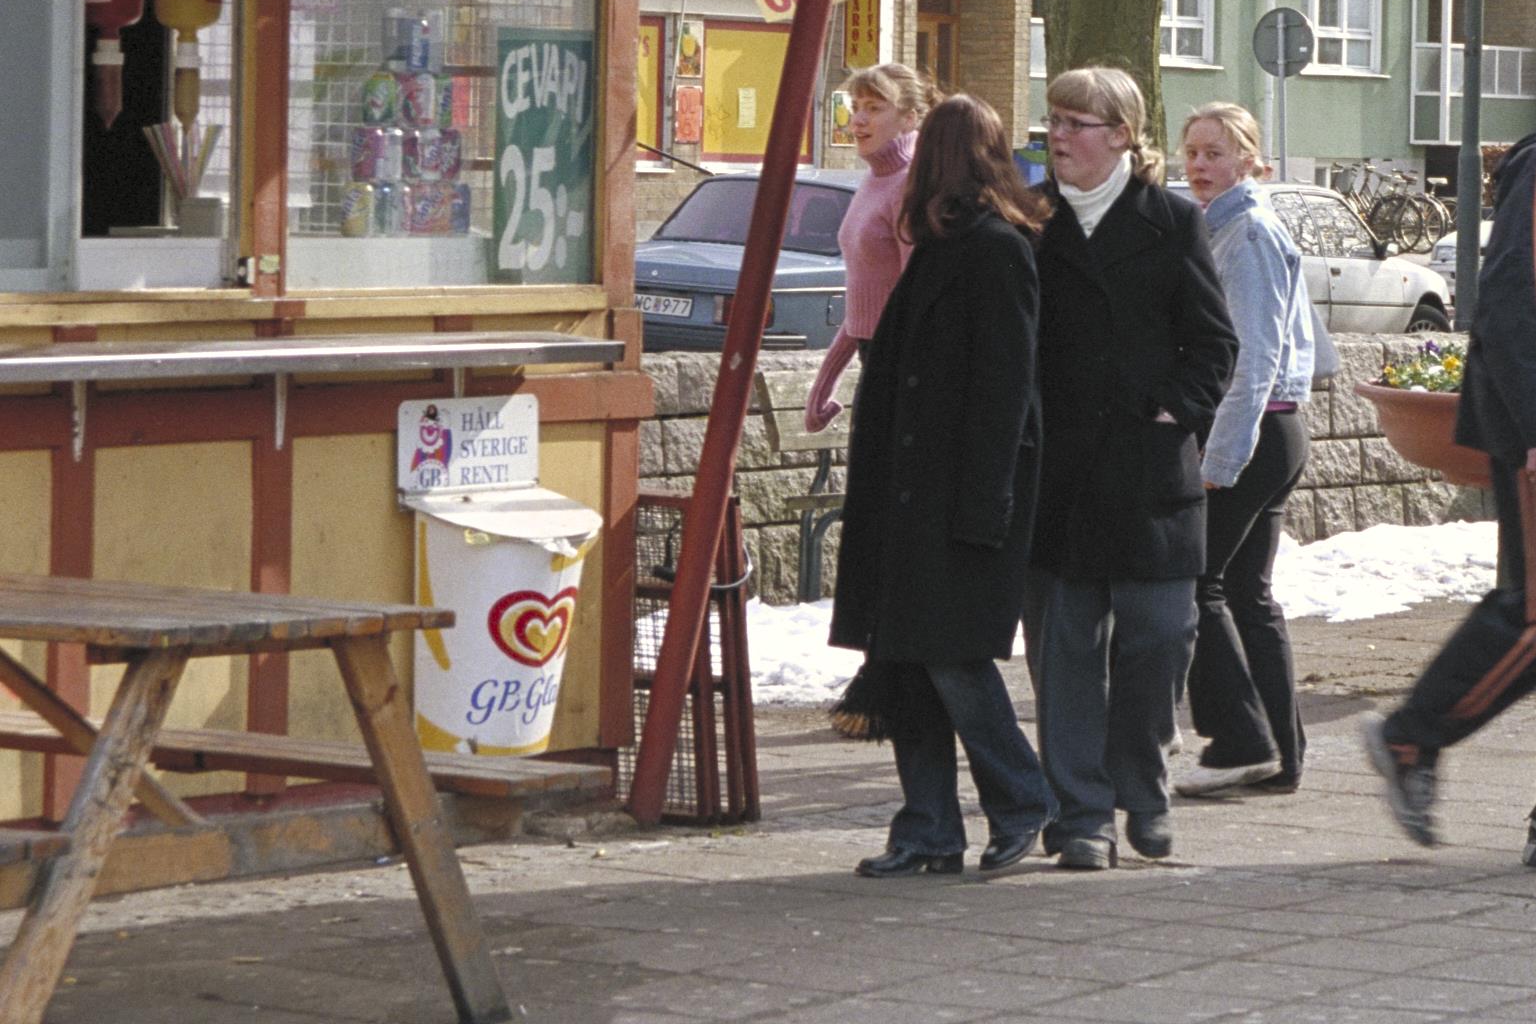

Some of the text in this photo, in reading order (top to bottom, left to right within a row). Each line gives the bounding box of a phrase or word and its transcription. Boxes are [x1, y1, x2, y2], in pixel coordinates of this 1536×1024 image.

[501, 42, 587, 124] CEVAPI
[498, 144, 585, 270] 25:-
[634, 295, 690, 314] WC 977
[461, 406, 504, 432] HÅLL
[460, 436, 528, 458] SVERIGE
[460, 464, 509, 485] RENT!
[466, 679, 521, 725] GB
